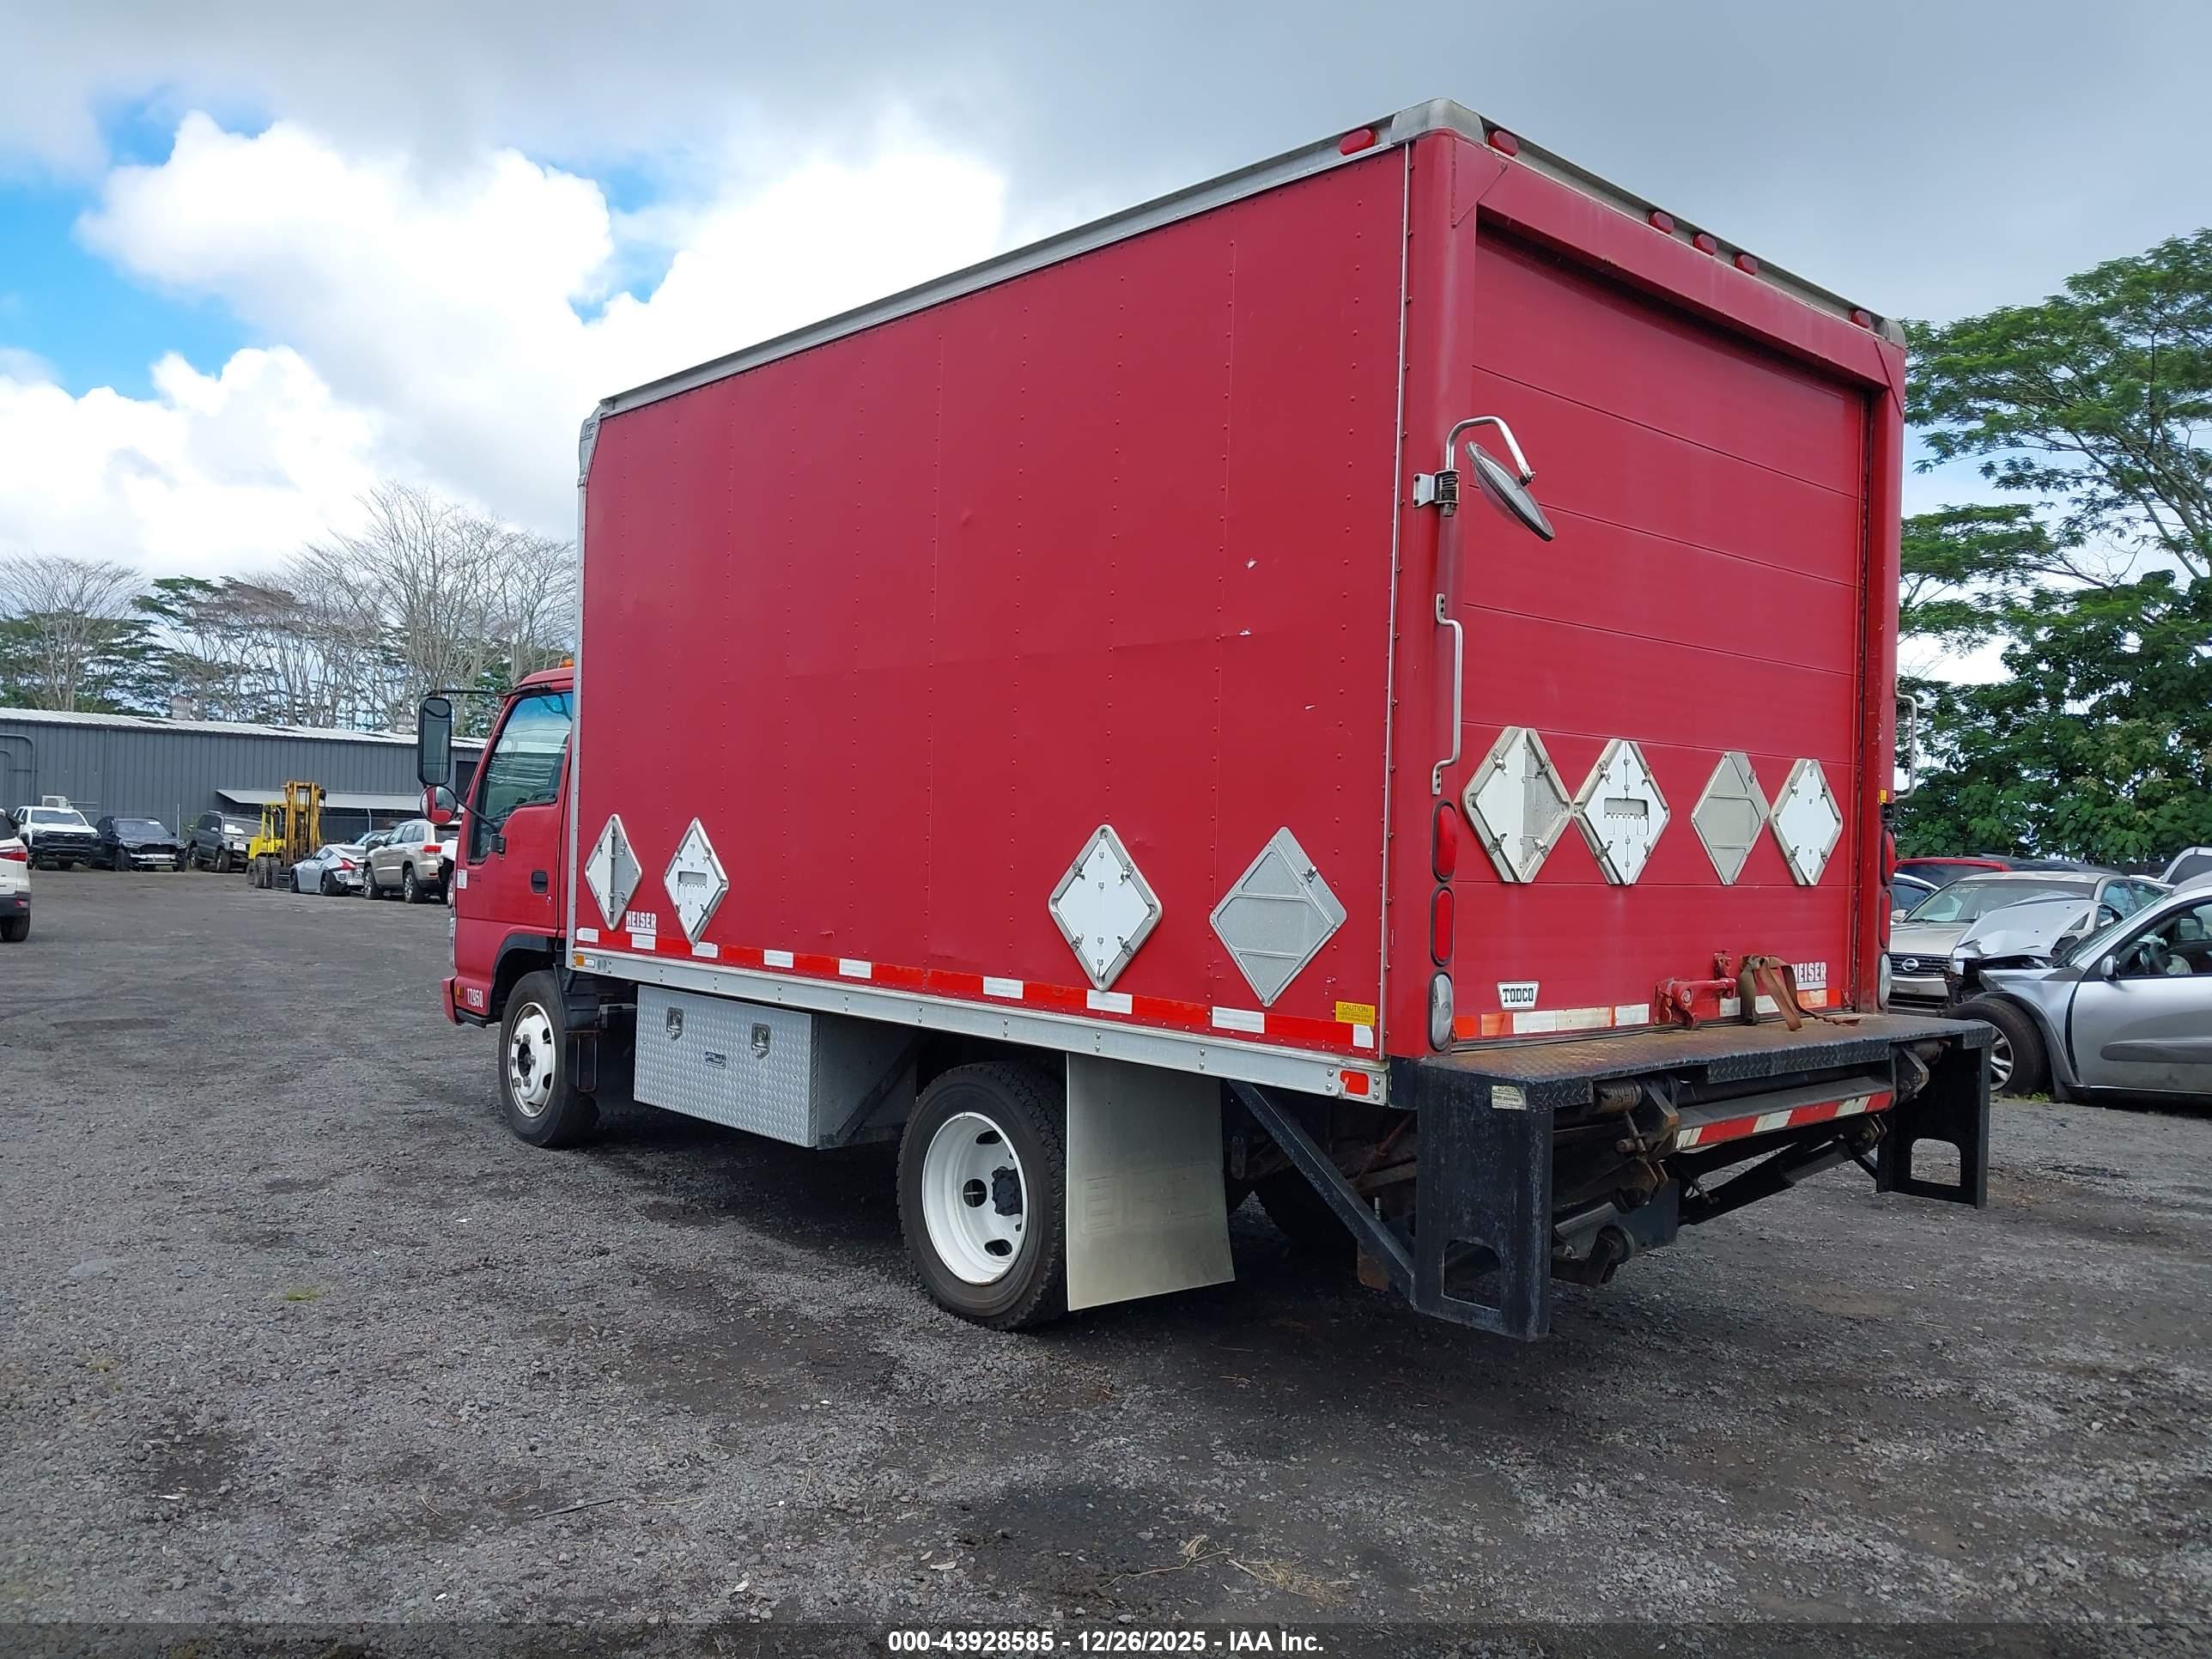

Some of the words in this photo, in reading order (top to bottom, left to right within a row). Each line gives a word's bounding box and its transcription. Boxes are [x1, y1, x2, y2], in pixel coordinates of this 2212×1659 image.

[626, 910, 657, 929] HEISER
[1791, 962, 1826, 983] HEISER
[1503, 988, 1534, 1002] TODCO
[1341, 1003, 1369, 1012] CAUTION
